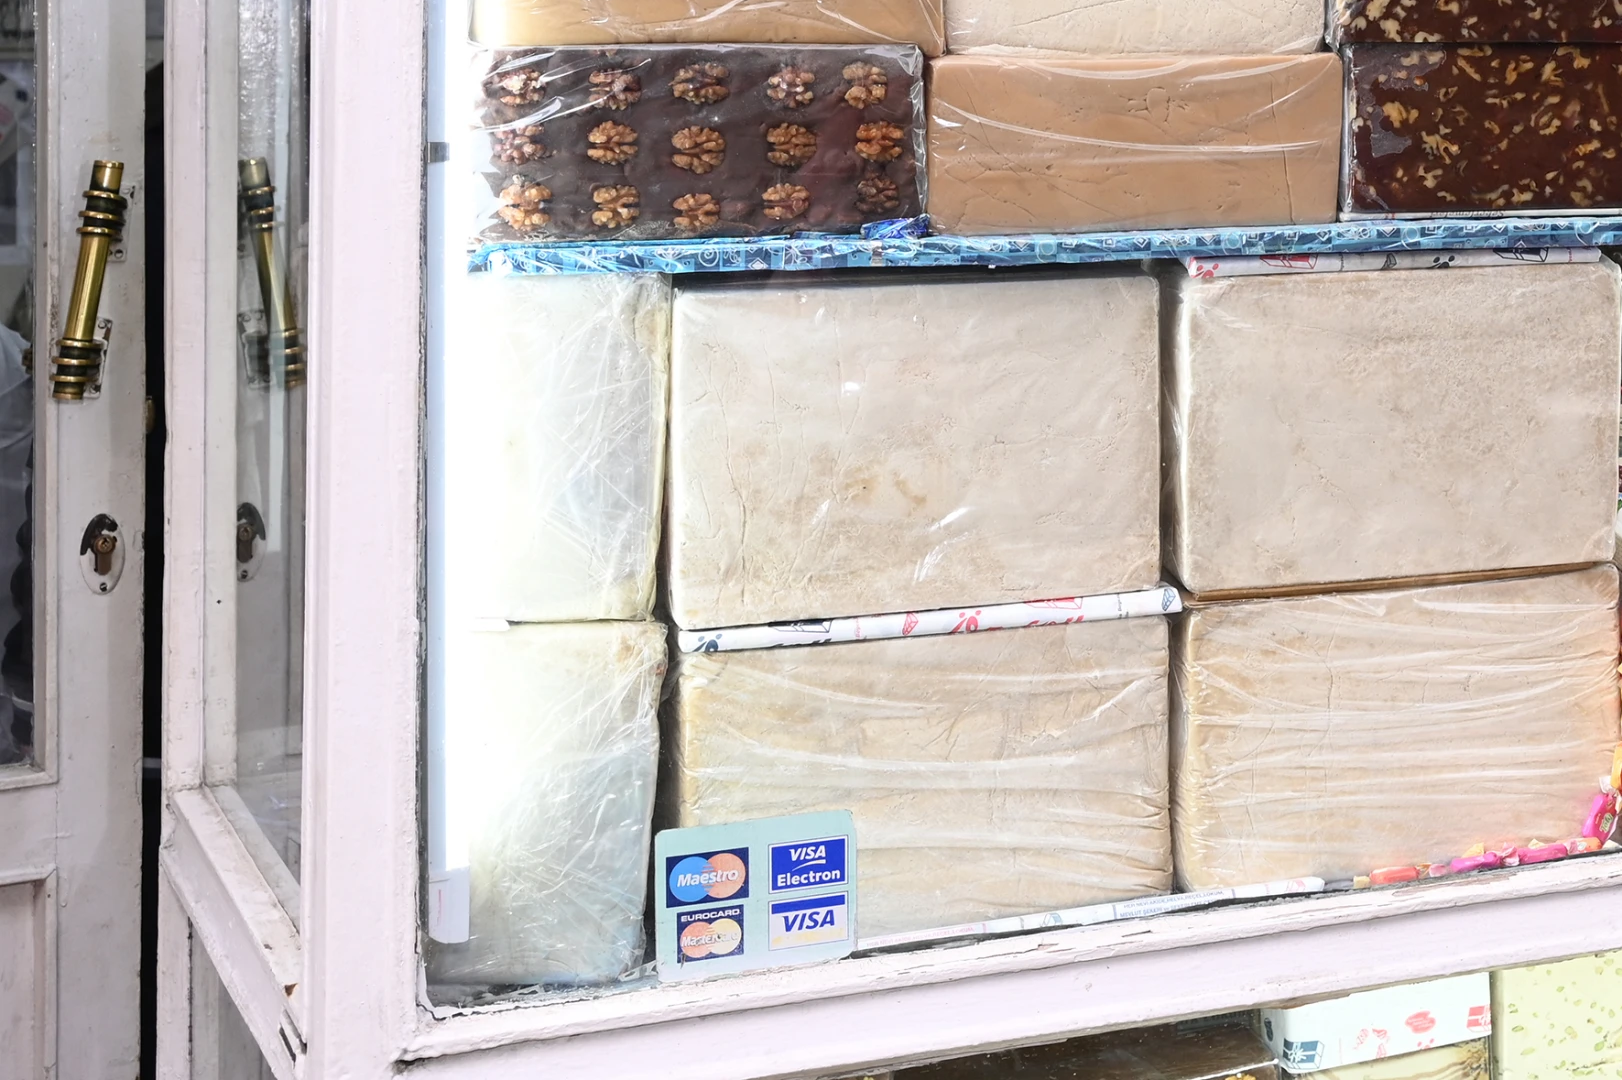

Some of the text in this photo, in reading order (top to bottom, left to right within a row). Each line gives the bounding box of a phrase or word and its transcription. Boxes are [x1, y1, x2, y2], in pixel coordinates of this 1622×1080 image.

[789, 845, 826, 861] VISA
[677, 868, 739, 888] Maestro
[777, 869, 840, 887] Electron
[681, 908, 741, 922] EUROCARD
[782, 910, 836, 932] VISA
